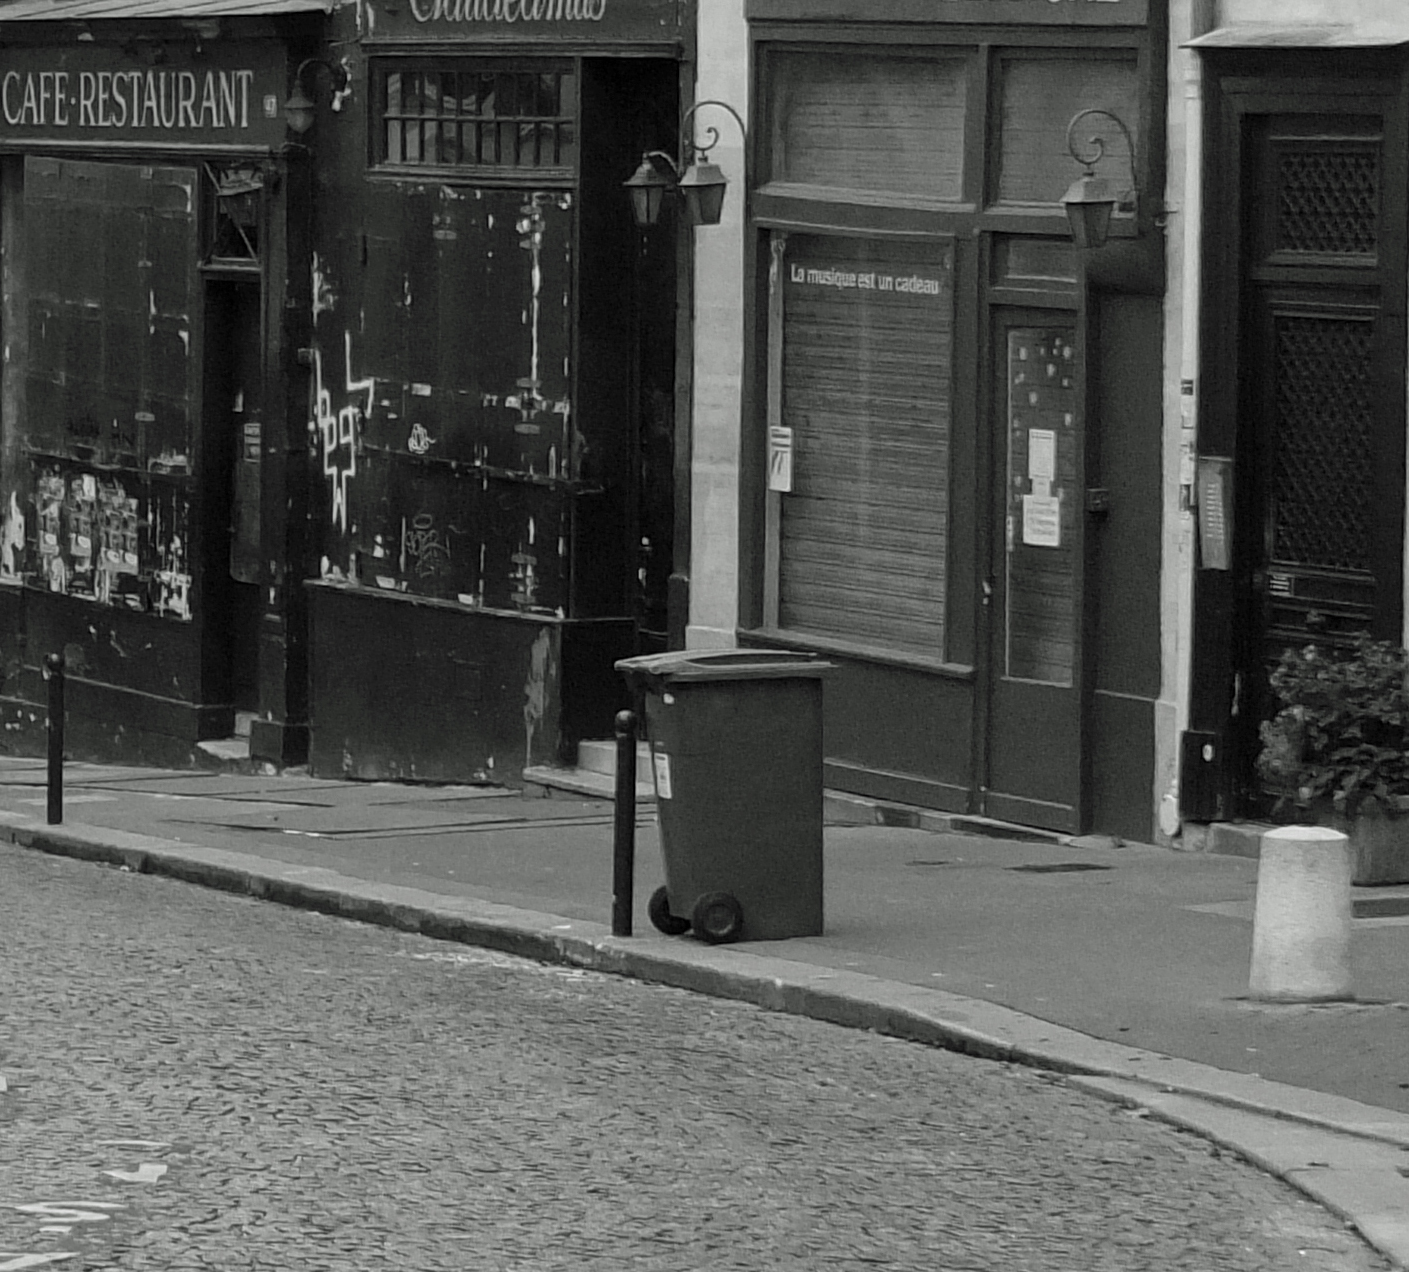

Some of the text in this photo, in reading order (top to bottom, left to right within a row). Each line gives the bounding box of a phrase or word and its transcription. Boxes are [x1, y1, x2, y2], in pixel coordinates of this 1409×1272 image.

[790, 263, 940, 295] La musique est un cadeau
